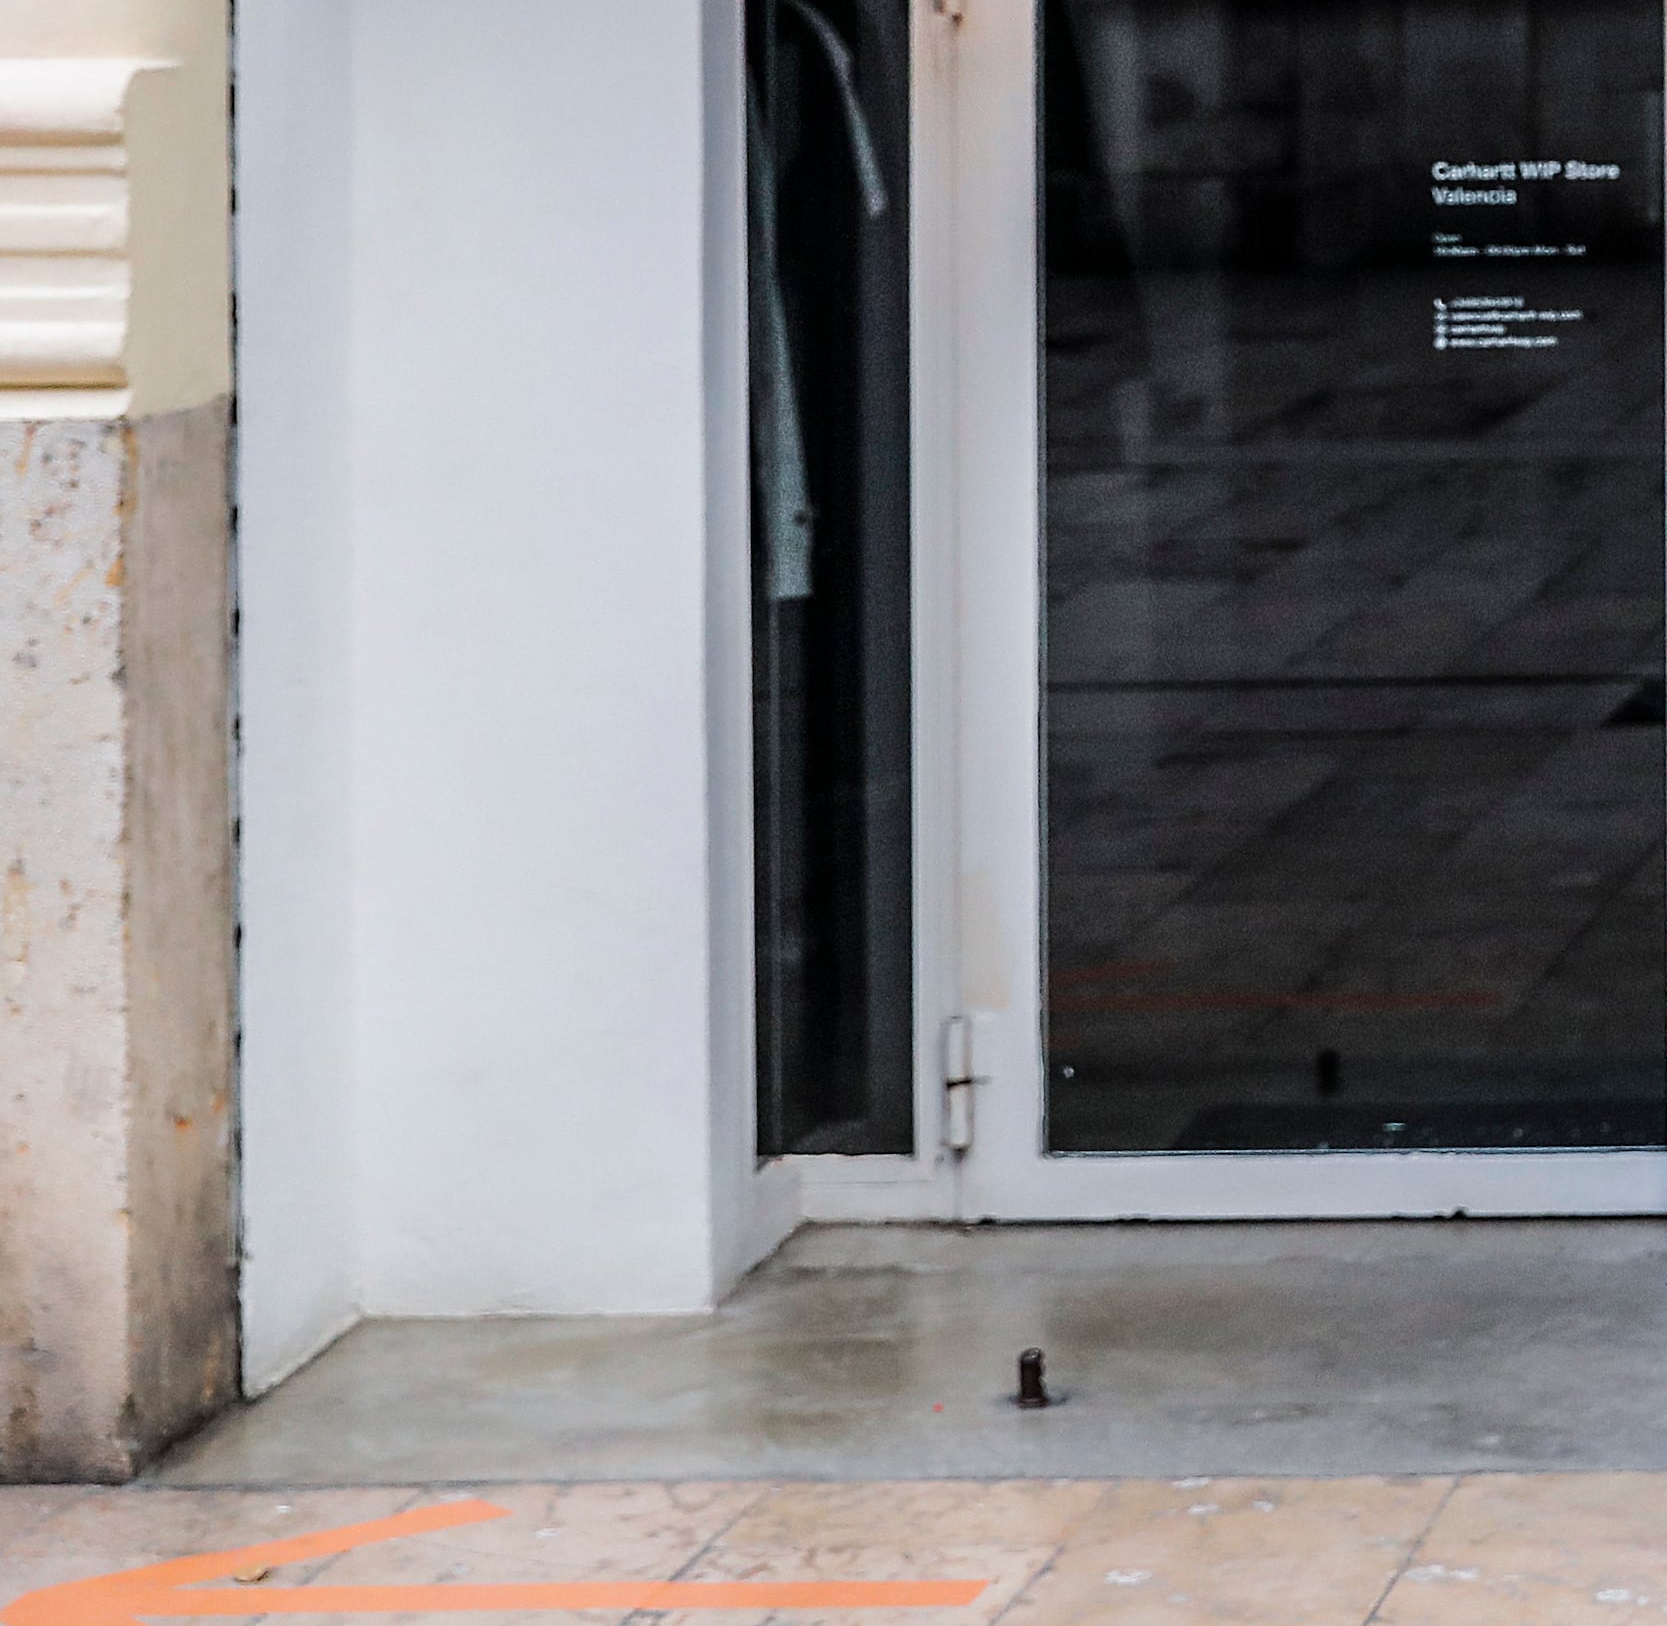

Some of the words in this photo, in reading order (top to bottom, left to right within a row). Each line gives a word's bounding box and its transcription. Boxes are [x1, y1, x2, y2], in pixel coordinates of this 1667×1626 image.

[1432, 160, 1516, 180] Carhartt
[1520, 160, 1562, 180] WIP
[1565, 160, 1621, 180] Store
[1432, 186, 1517, 206] Valencia
